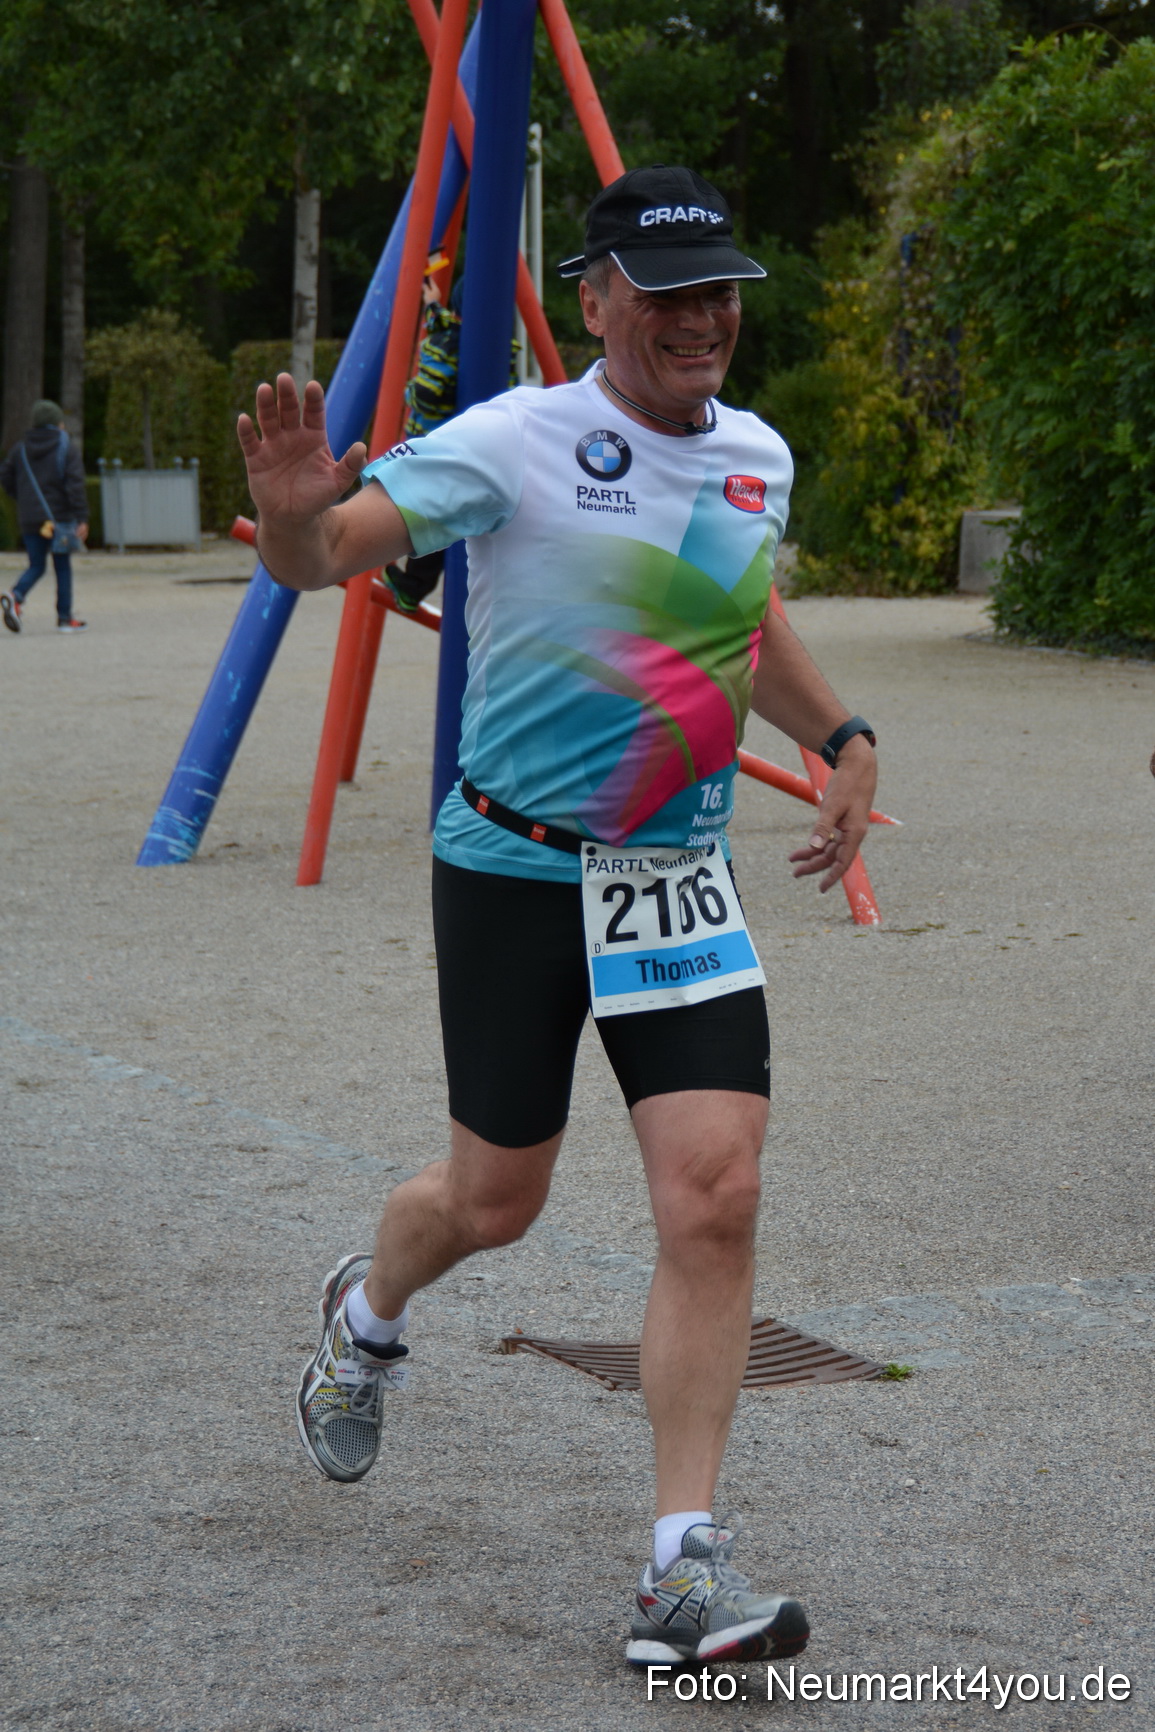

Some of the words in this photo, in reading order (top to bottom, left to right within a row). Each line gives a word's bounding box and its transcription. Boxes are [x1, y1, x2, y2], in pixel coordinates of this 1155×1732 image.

[640, 206, 707, 227] CRAFT
[580, 431, 627, 450] BMW
[576, 485, 637, 505] PARTL
[577, 500, 637, 515] Neumarkt
[701, 783, 724, 809] 16.
[586, 858, 649, 873] PARTL
[602, 866, 728, 944] 2166
[635, 952, 721, 984] Thomas
